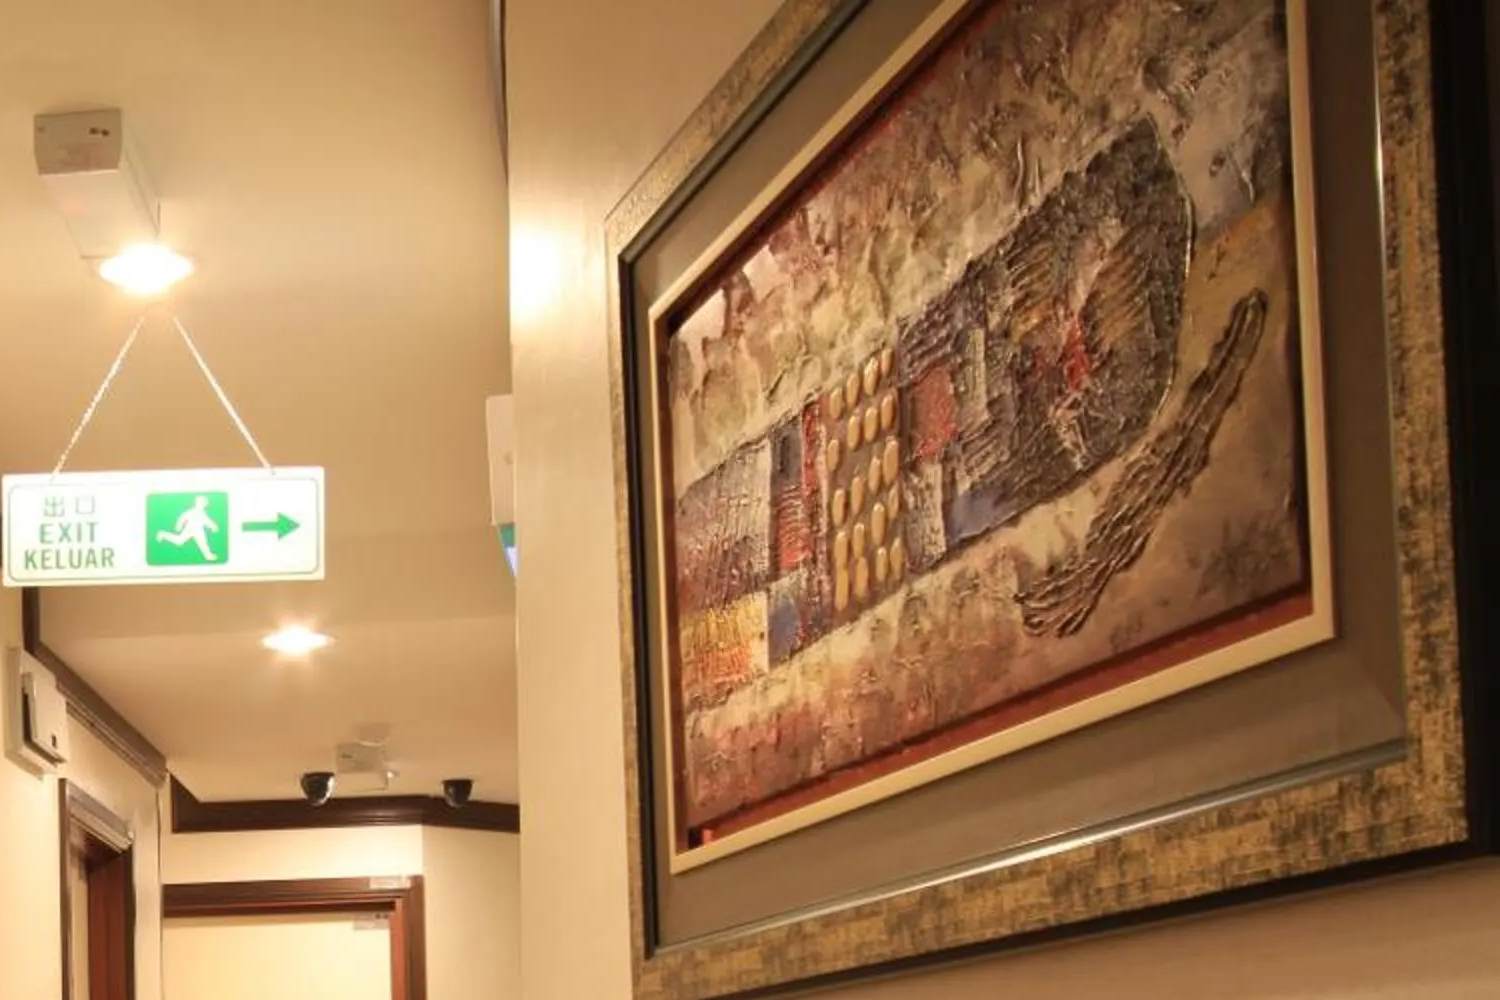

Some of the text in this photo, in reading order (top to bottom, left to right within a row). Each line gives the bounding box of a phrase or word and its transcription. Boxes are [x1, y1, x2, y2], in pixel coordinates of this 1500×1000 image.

[43, 496, 96, 517] 出口
[39, 521, 99, 544] EXIT
[23, 547, 116, 571] KELUAR
